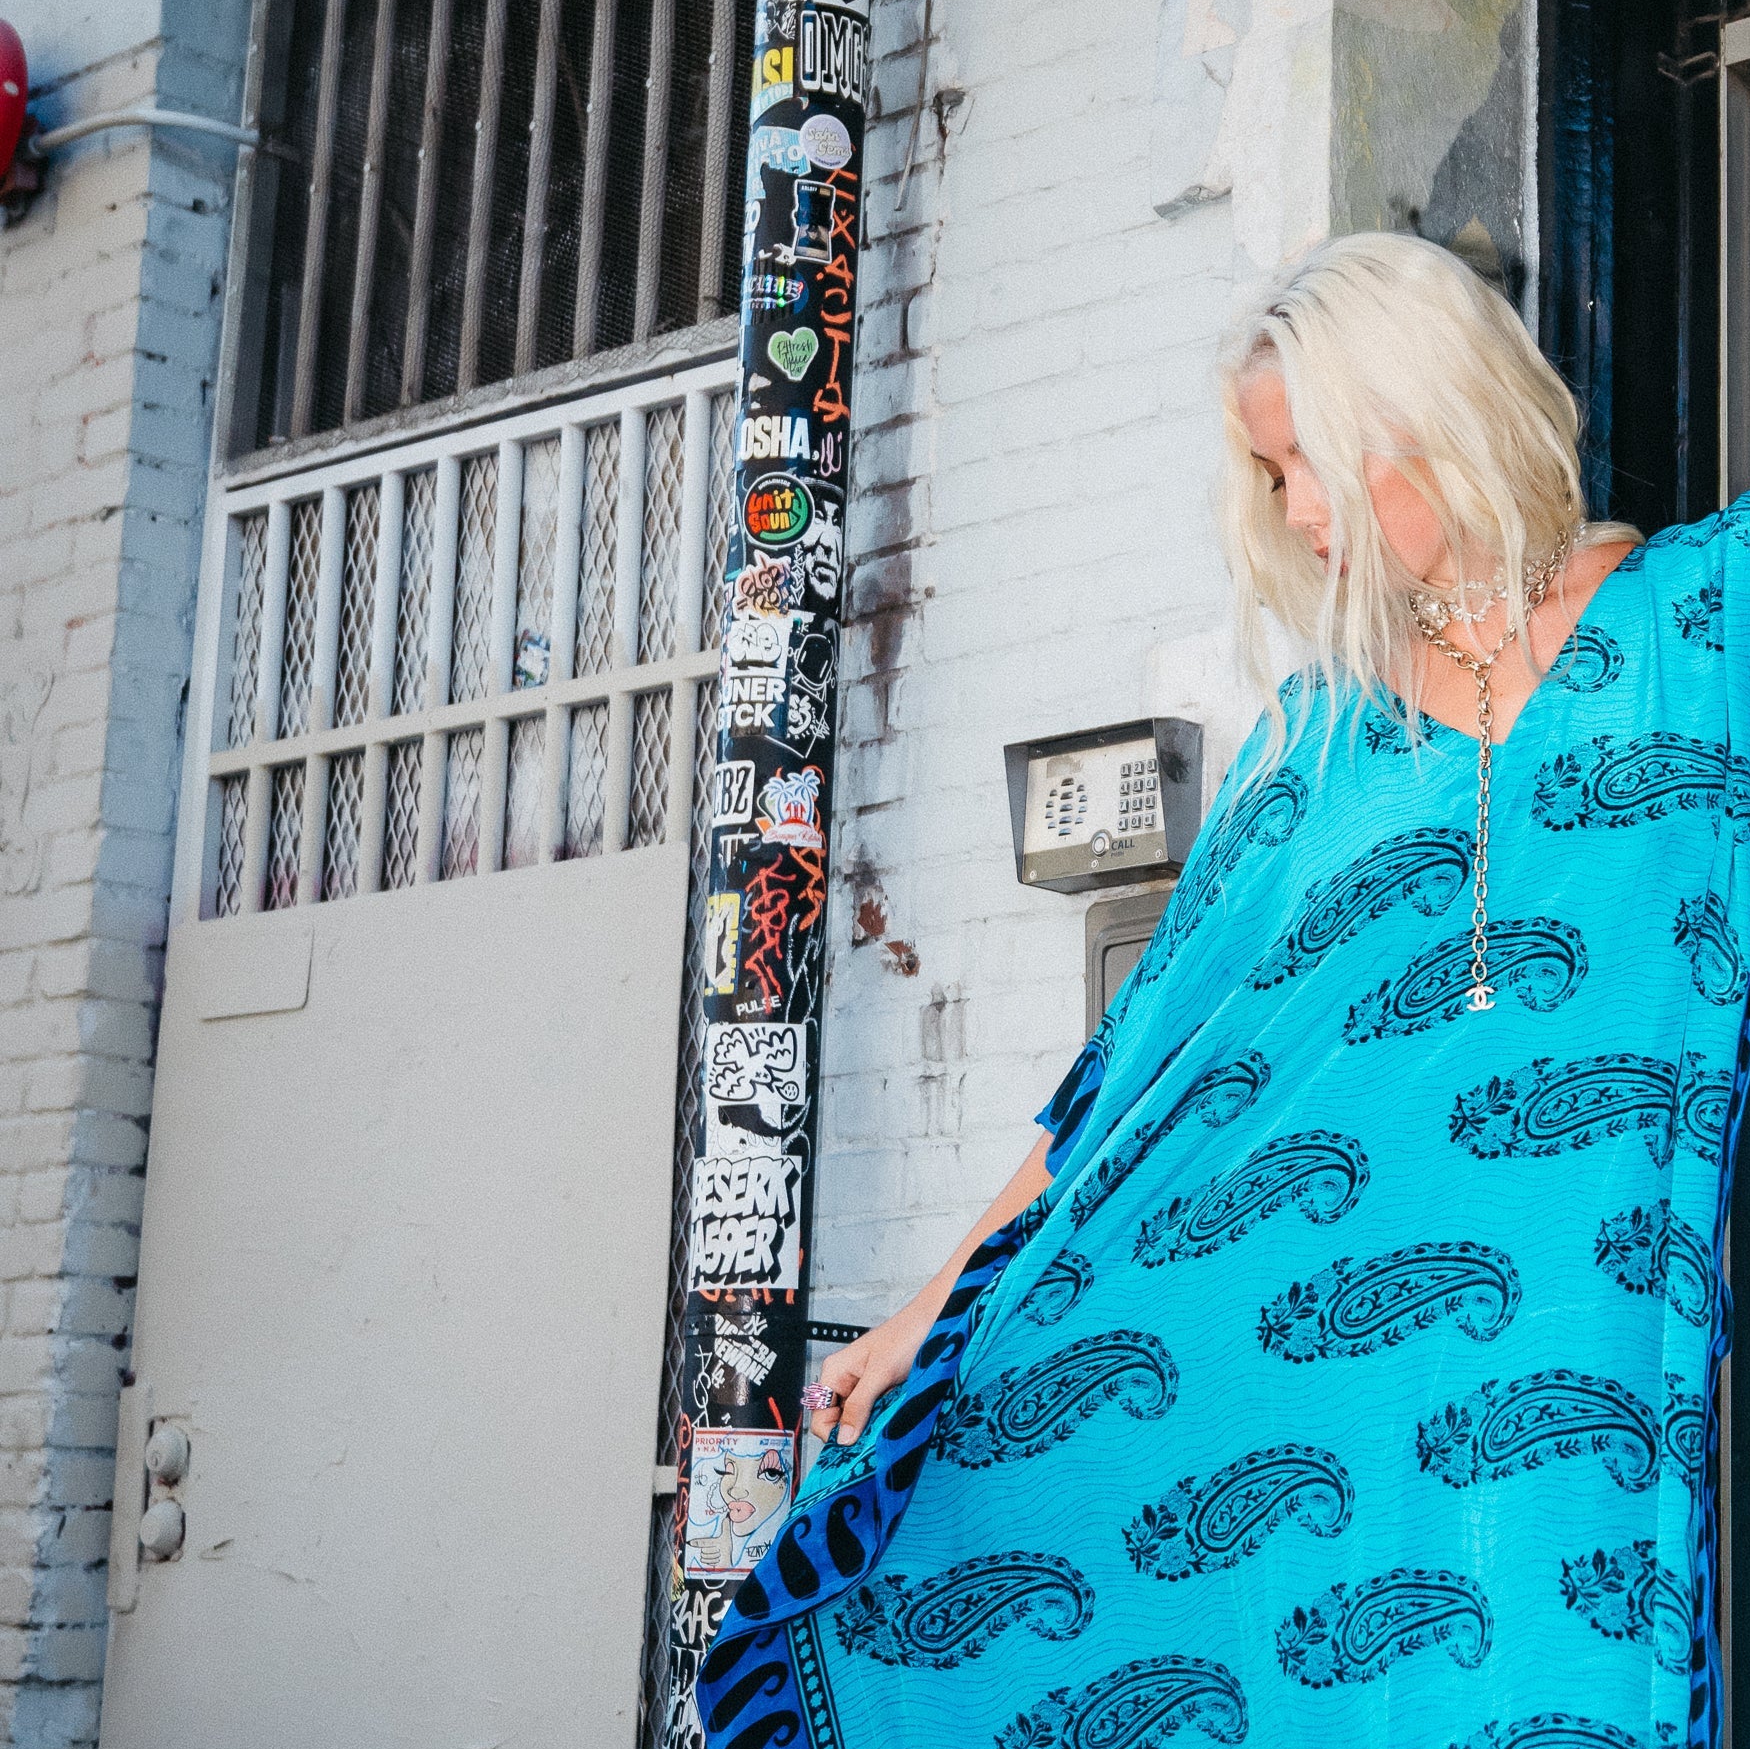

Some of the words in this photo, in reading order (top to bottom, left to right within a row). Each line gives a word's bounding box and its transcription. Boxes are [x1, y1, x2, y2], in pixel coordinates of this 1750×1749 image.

[739, 415, 811, 461] OSHA
[1111, 838, 1135, 851] CALL
[695, 1437, 739, 1446] PRIORITY
